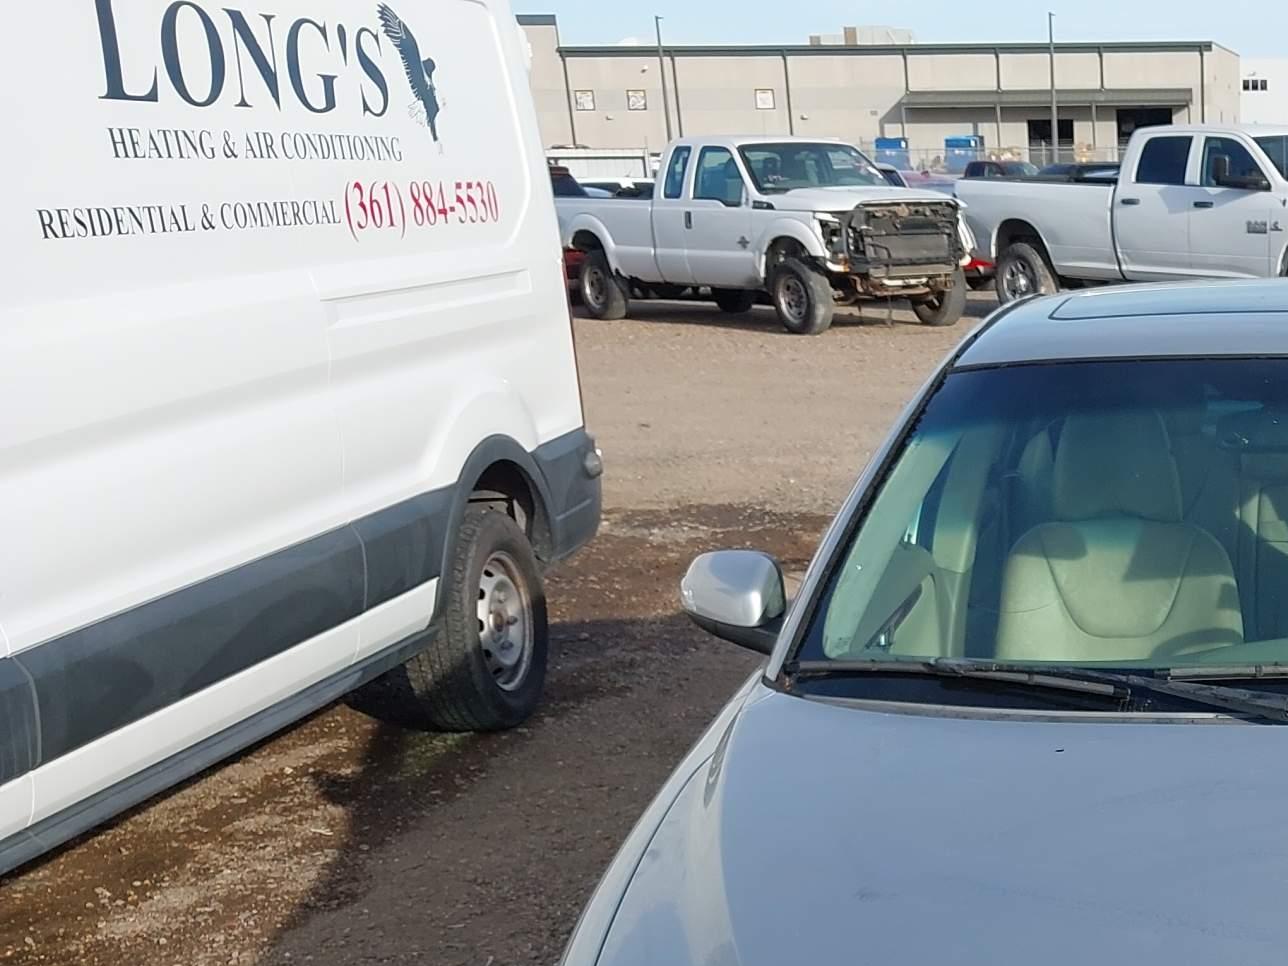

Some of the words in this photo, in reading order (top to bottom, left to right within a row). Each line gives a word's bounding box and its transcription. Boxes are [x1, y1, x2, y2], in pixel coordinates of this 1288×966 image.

[94, 0, 389, 117] LONG'S
[107, 128, 215, 160] HEATING
[222, 130, 239, 160] &
[245, 130, 277, 160] AIR
[281, 132, 402, 162] CONDITIONING
[36, 204, 196, 240] RESIDENTIAL
[201, 203, 216, 231] &
[220, 200, 342, 230] COMMERCIAL
[345, 180, 406, 242] (361)
[409, 180, 499, 226] 884-5530
